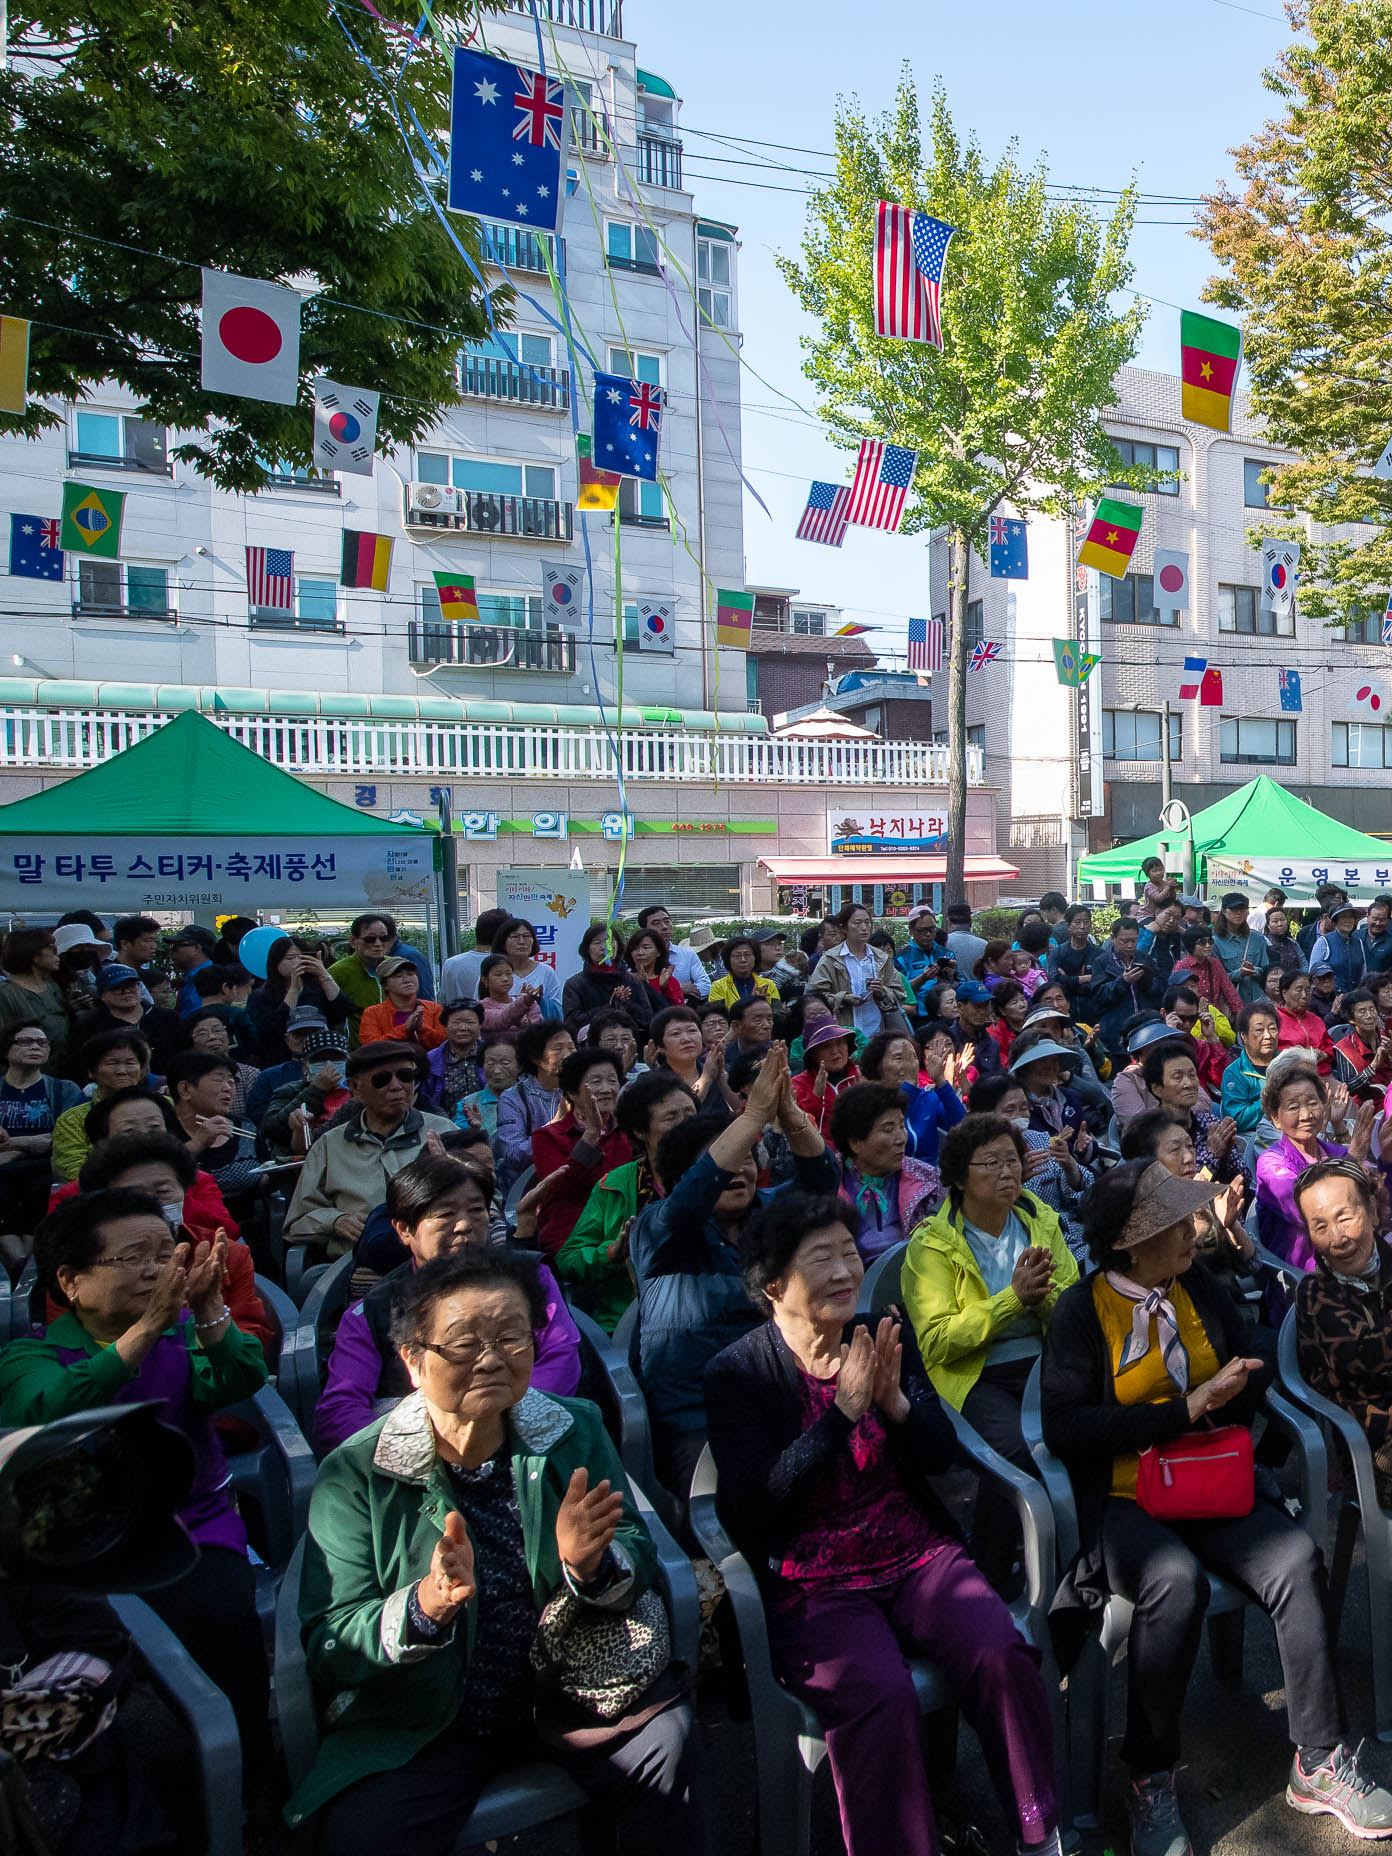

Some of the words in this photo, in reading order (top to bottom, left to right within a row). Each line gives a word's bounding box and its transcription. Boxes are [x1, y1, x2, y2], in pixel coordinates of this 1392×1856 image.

[671, 823, 727, 832] 446-1275
[869, 816, 944, 838] 낙지나라
[14, 854, 46, 884] 말
[55, 854, 118, 882] 타투
[126, 852, 337, 882] 스티커·축제풍선
[1278, 867, 1391, 887] 운영본부
